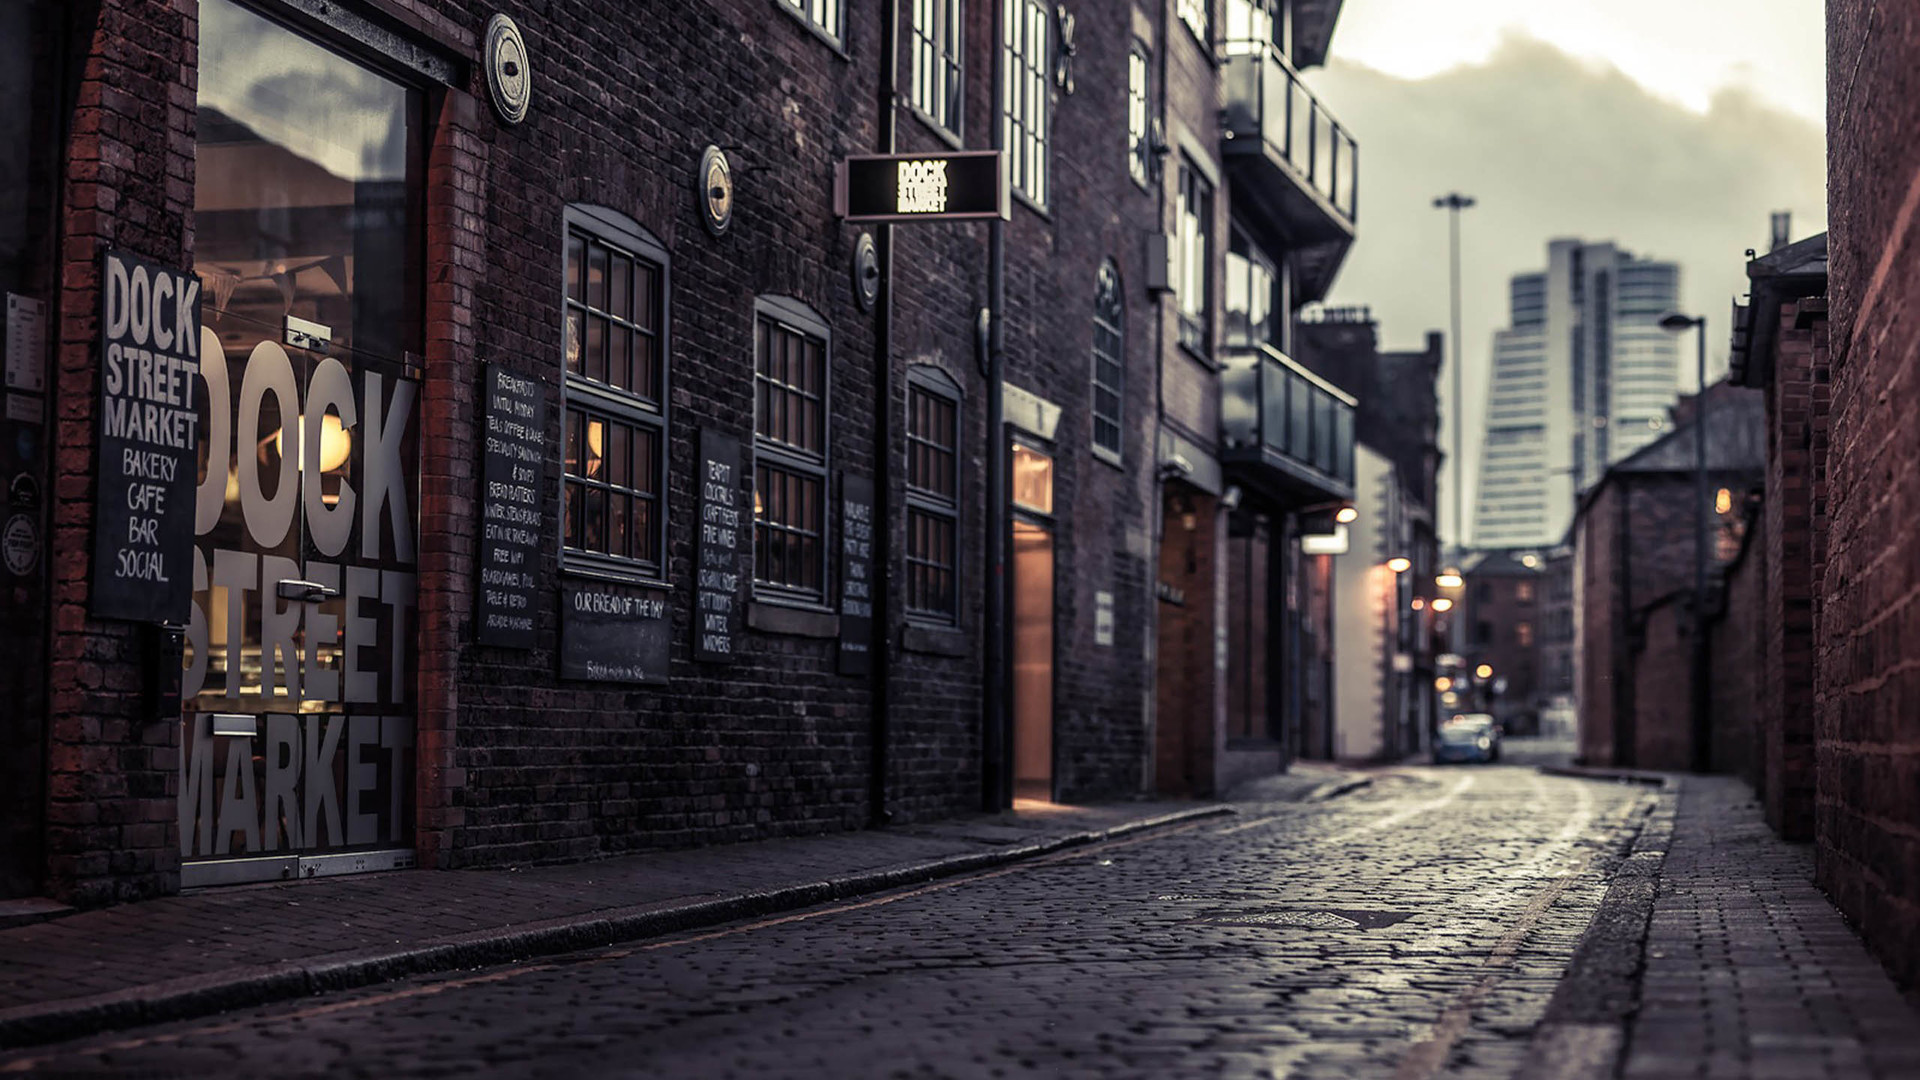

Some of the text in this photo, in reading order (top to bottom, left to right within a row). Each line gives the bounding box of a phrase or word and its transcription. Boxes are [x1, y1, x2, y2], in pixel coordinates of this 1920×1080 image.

[106, 255, 198, 356] DOCK
[106, 347, 199, 410] STREET
[104, 397, 199, 450] MARKET
[487, 415, 503, 433] TEAS
[504, 420, 524, 439] COFFEE
[123, 448, 178, 483] BAKERY
[127, 483, 165, 514] CAFE
[703, 504, 722, 523] CRAFT
[129, 516, 159, 546] BAR
[703, 524, 717, 544] FINE
[116, 548, 169, 583] SOCIAL
[494, 548, 509, 563] FREE
[575, 592, 664, 619] OUR BREAD OF THE DAY
[705, 613, 728, 633] WINTER
